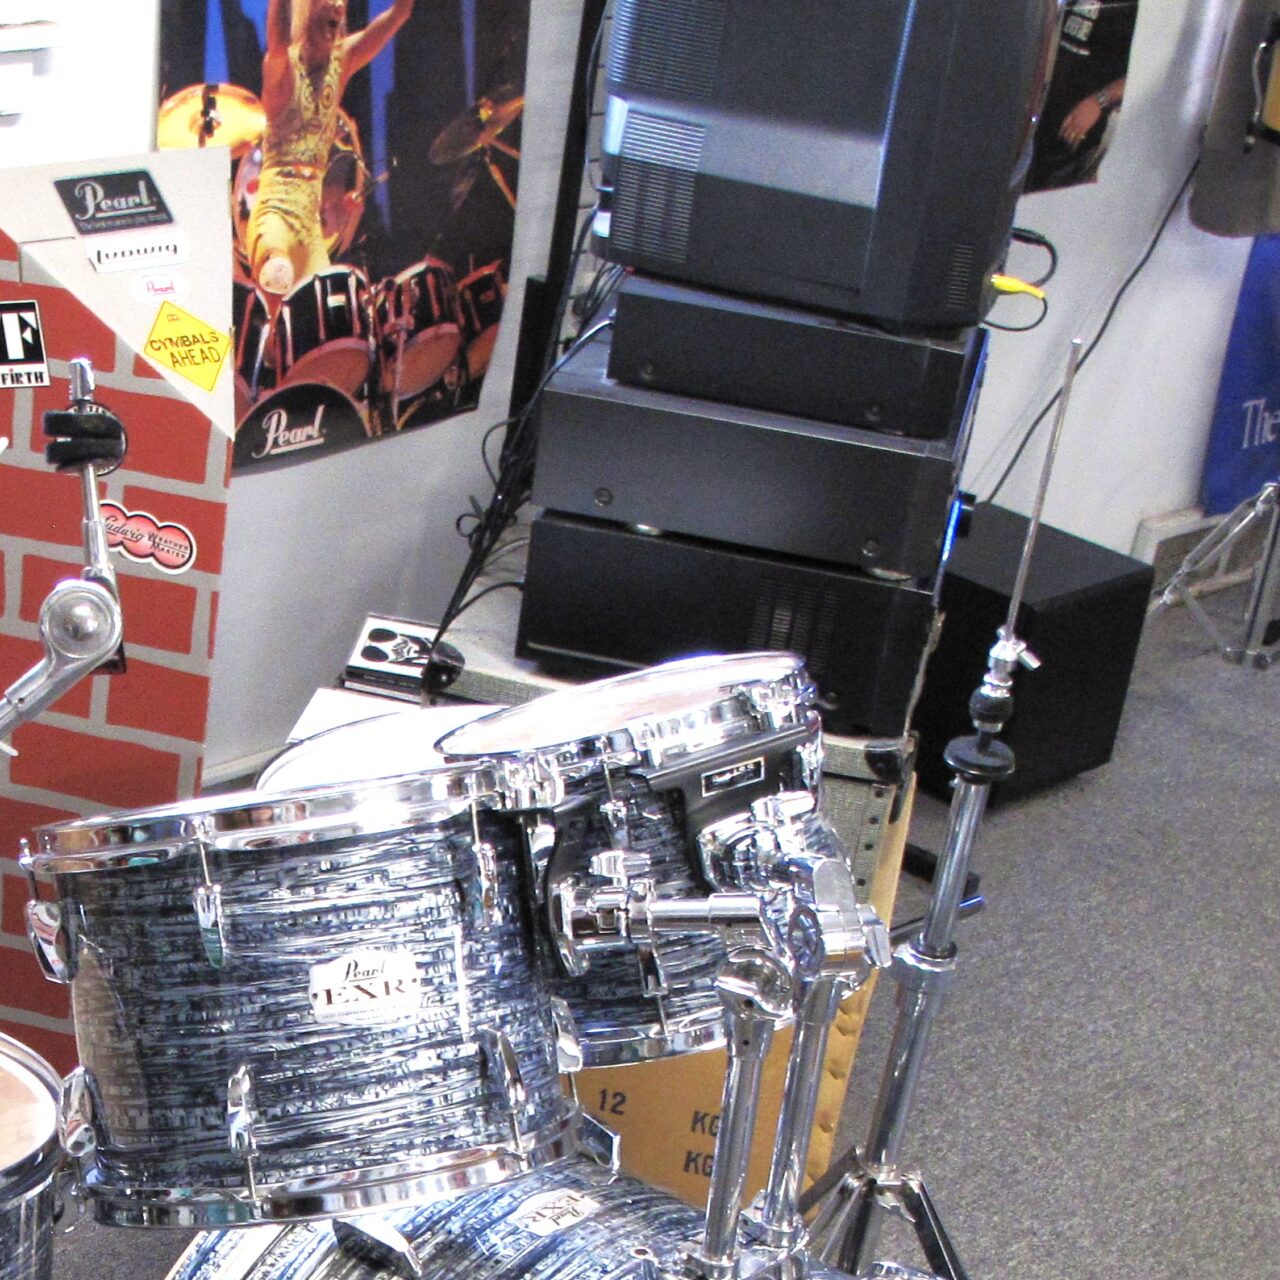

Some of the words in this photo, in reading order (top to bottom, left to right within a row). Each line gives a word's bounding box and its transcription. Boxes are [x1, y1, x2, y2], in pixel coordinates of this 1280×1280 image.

[75, 180, 151, 220] Pearl
[149, 331, 220, 351] CYMBALS
[169, 347, 221, 369] AHEAD
[251, 404, 326, 459] Pearl
[344, 959, 386, 983] Pearl
[323, 979, 406, 1006] EXR
[599, 1088, 627, 1116] 12
